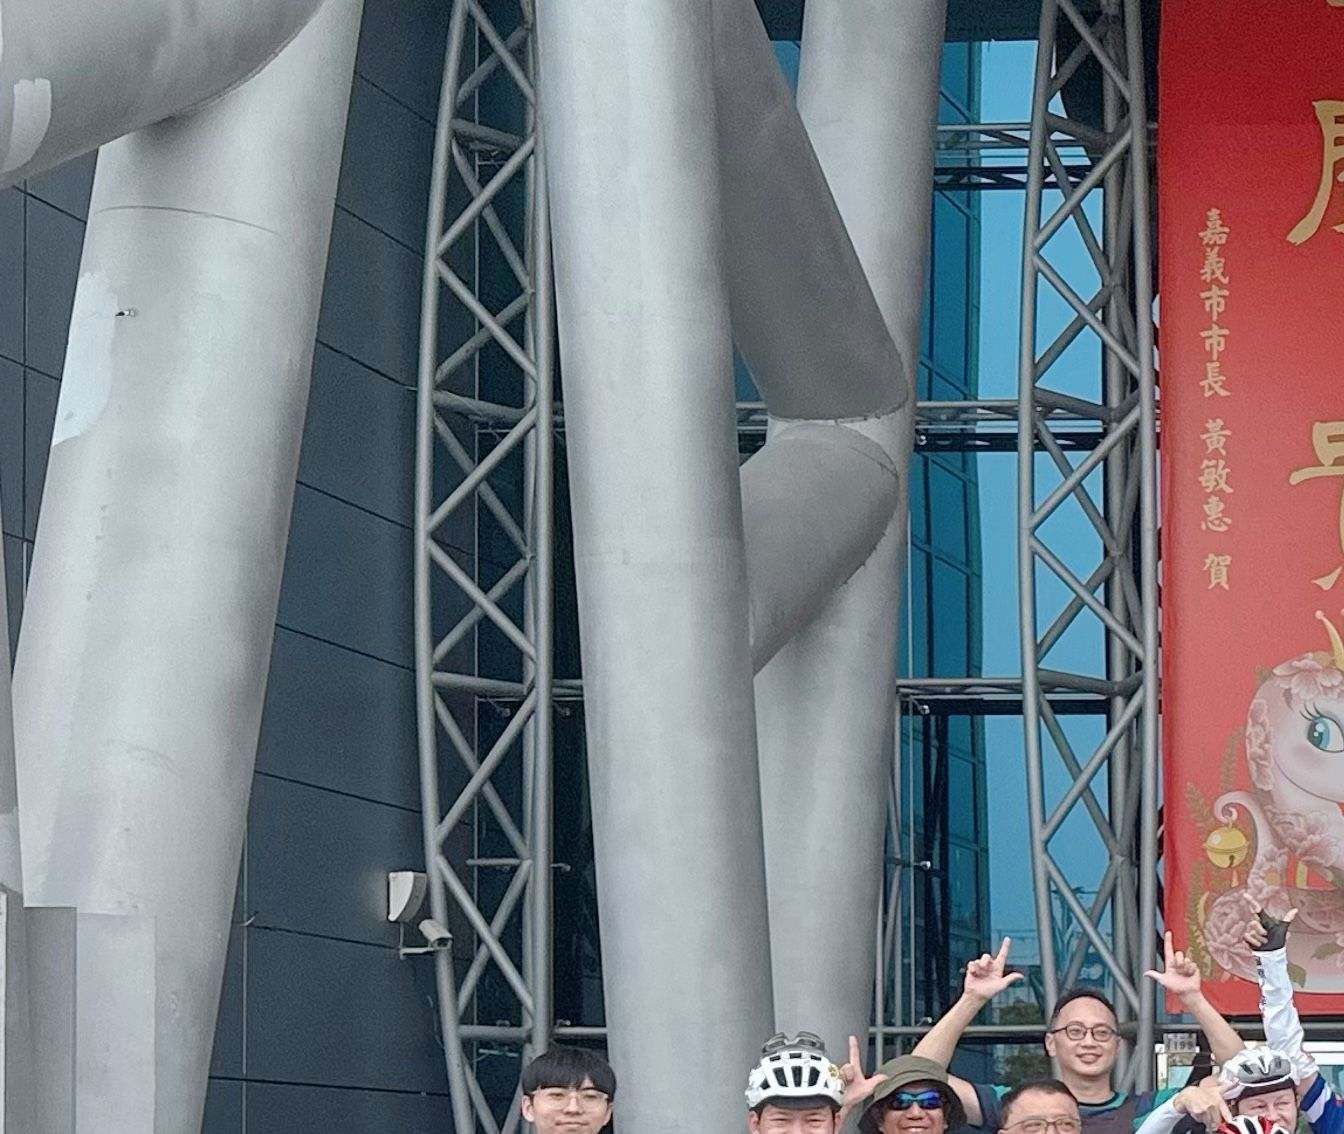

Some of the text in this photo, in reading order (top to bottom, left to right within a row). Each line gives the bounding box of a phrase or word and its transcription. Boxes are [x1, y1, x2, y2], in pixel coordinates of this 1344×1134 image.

[1199, 208, 1233, 591] 嘉義市市長 黃敏惠 賀
